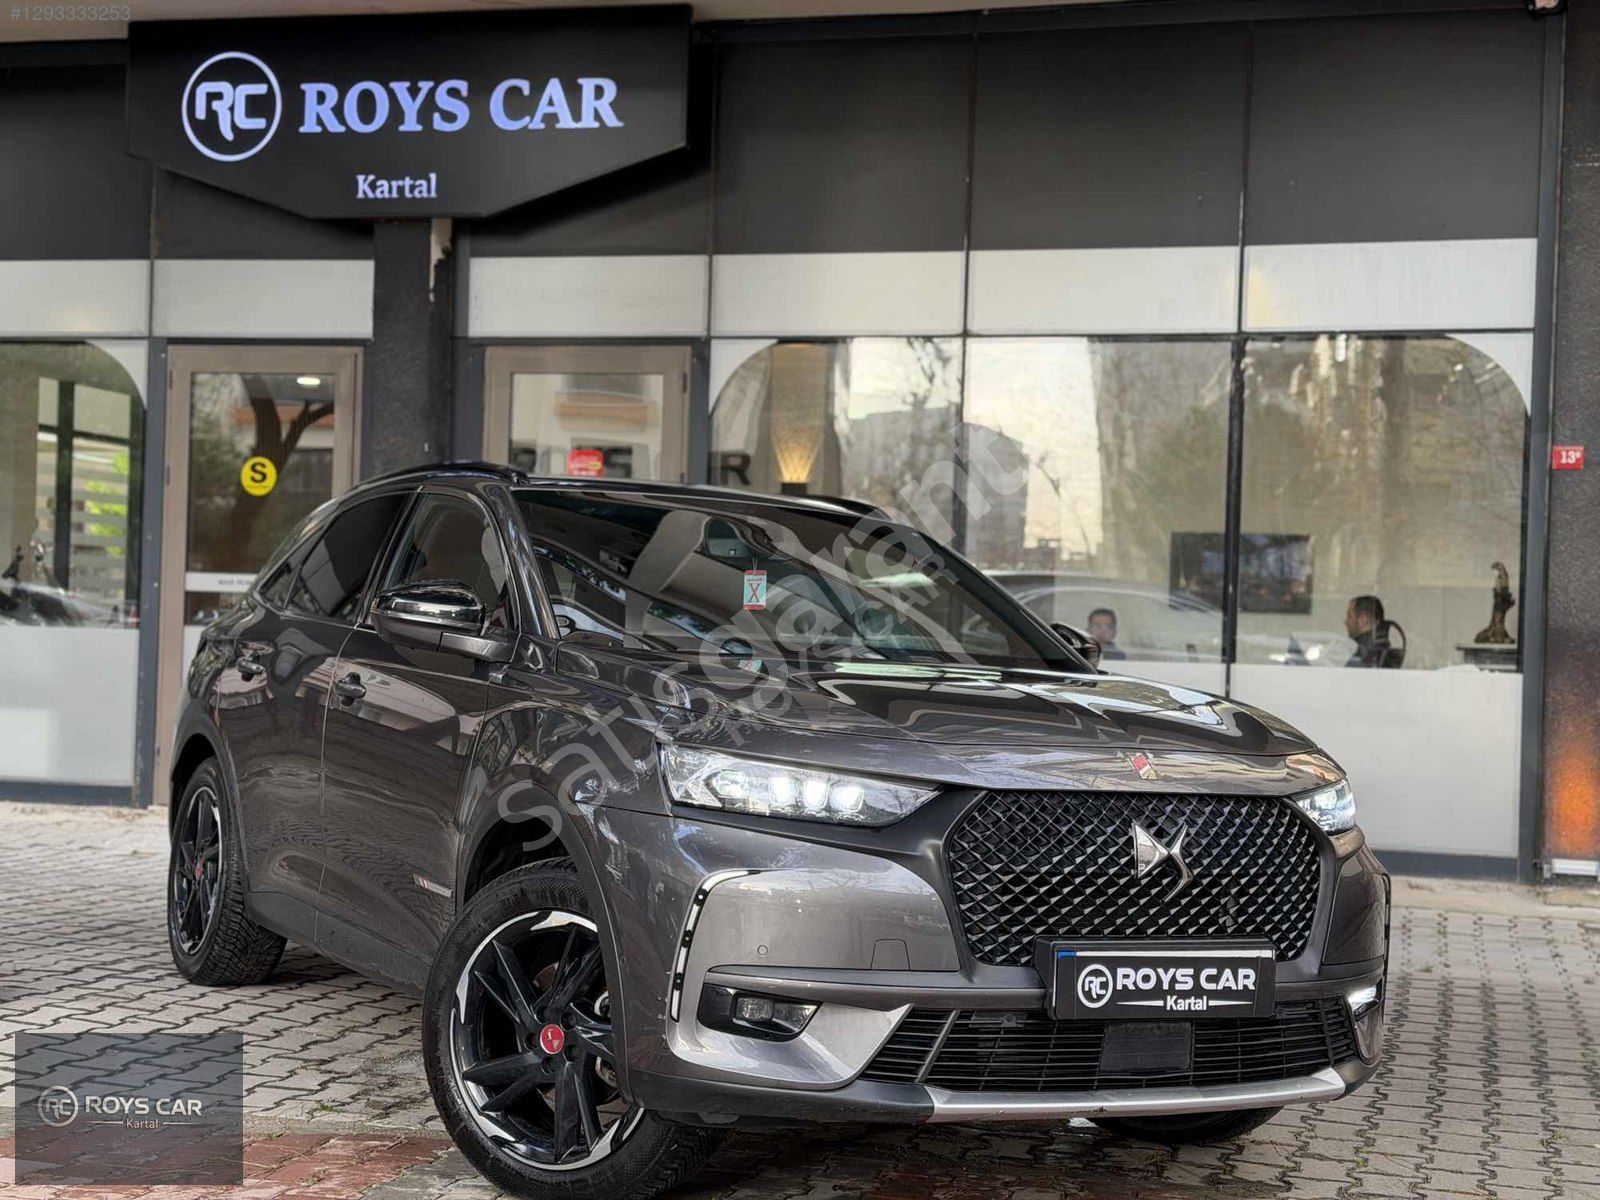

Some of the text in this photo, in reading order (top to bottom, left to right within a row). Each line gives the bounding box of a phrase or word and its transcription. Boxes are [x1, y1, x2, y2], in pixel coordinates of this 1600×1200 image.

[299, 79, 471, 134] ROYS
[489, 77, 624, 131] CAR
[356, 172, 438, 200] Kartal
[250, 462, 267, 483] S
[1116, 968, 1195, 991] ROYS
[1199, 967, 1256, 991] CAR
[1166, 995, 1207, 1011] Kartal
